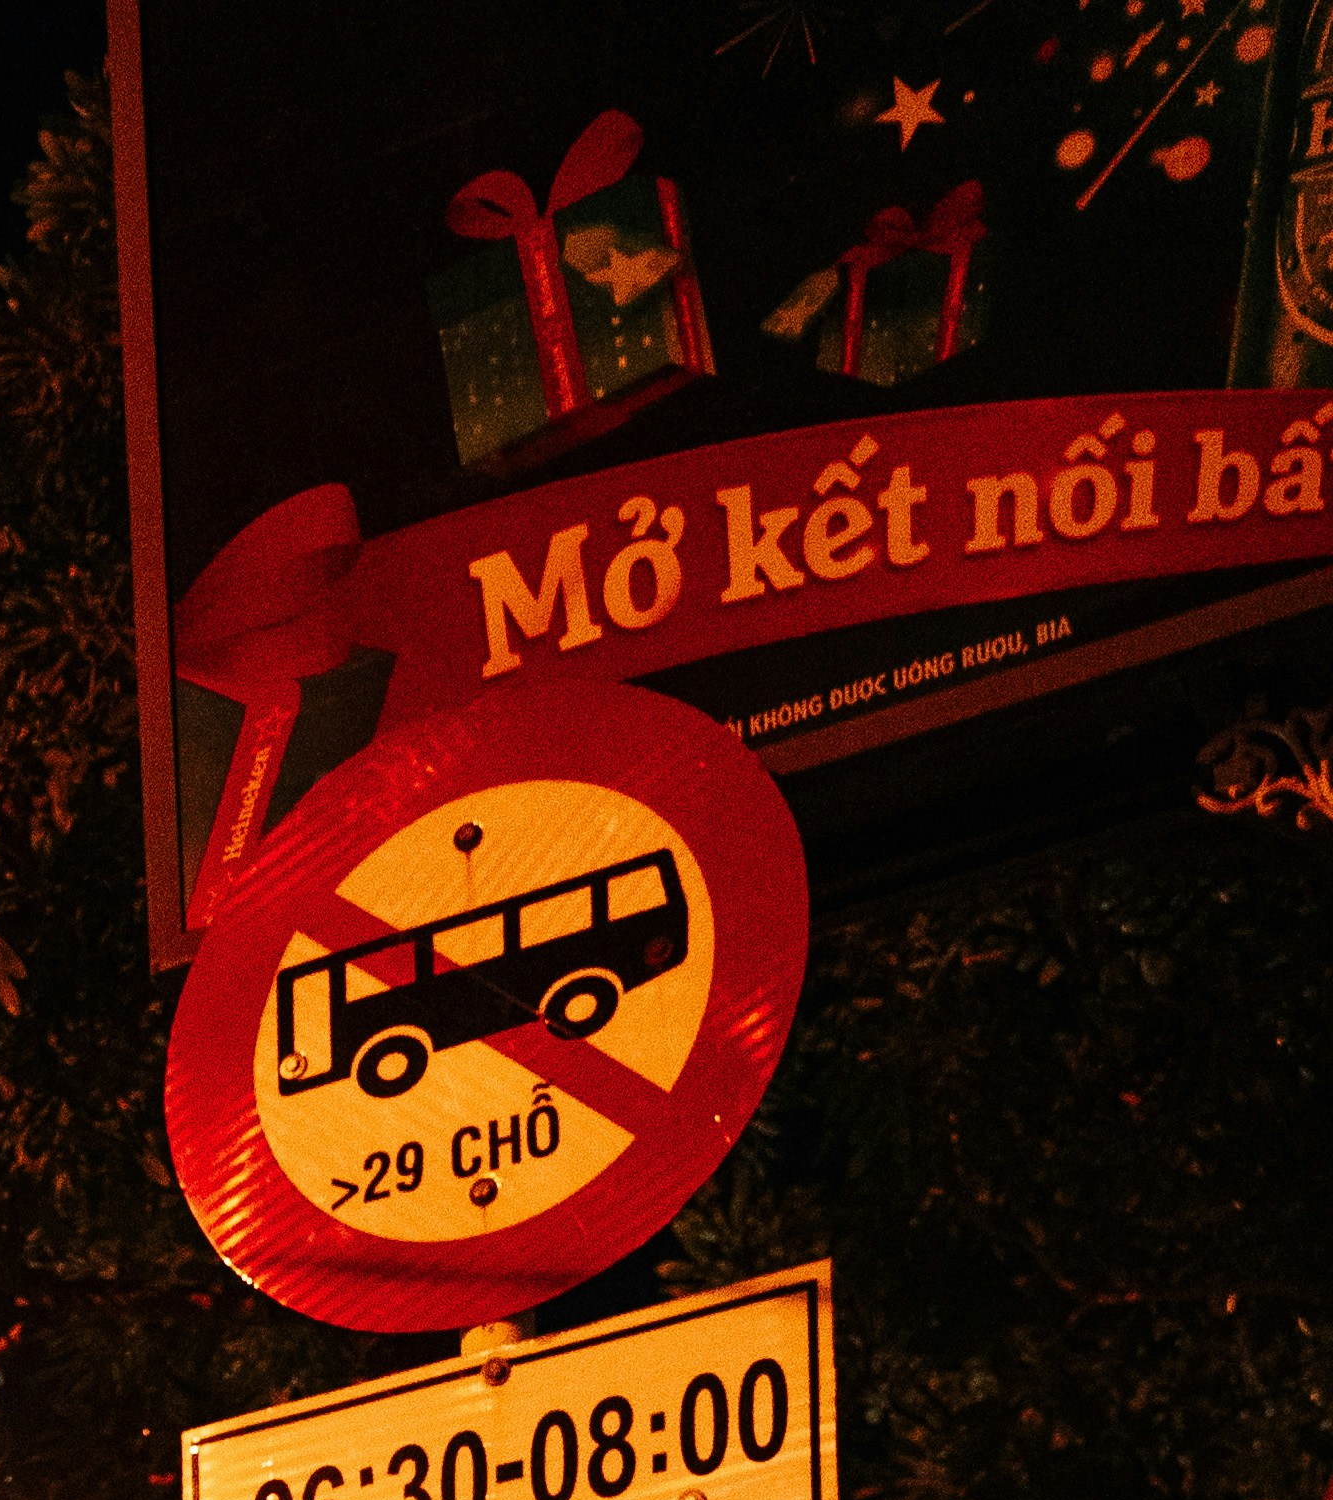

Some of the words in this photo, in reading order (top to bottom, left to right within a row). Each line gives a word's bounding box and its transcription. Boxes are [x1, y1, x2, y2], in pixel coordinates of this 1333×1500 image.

[469, 496, 686, 680] Mở
[716, 434, 931, 603] kết
[966, 414, 1162, 554] nối
[1187, 401, 1333, 524] bấ
[1035, 614, 1073, 647] BIA
[221, 745, 273, 864] Heineken
[330, 1140, 424, 1211] >29
